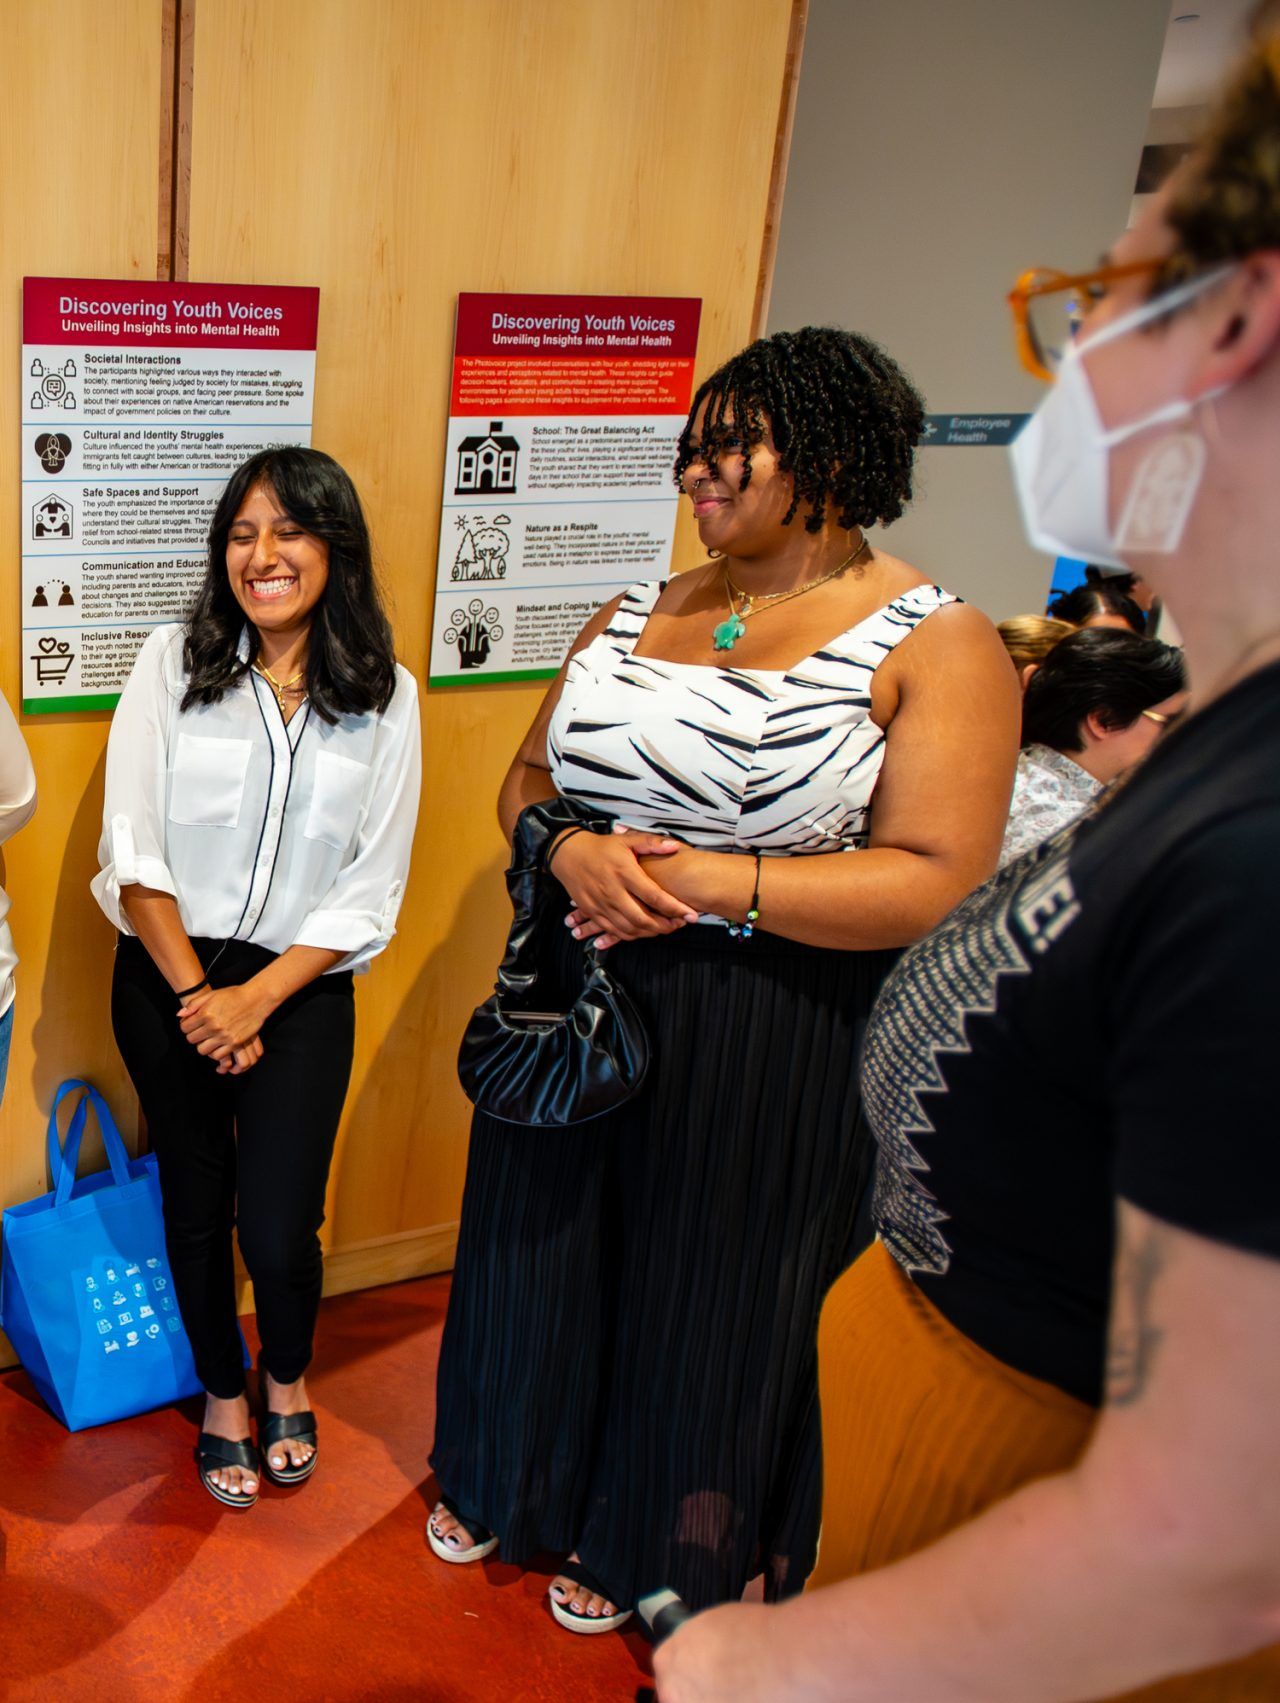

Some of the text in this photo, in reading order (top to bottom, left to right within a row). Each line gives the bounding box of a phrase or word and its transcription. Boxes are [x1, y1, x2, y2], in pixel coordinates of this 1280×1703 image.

[59, 296, 283, 321] Discovering Youth Voices
[62, 319, 280, 337] Unveiling Insights into Mental Health
[492, 313, 675, 334] Discovering Youth Voices
[492, 333, 672, 348] Unveiling Insights into Mental Health
[84, 353, 181, 365] Societal Interactions
[84, 366, 97, 374] The
[99, 367, 137, 376] participants
[139, 367, 175, 377] highlighted
[220, 369, 234, 377] they
[236, 369, 267, 377] interacted
[156, 389, 180, 397] groups,
[197, 388, 216, 397] facing
[234, 390, 264, 398] pressure.
[265, 389, 284, 397] Some
[285, 390, 304, 398] spoke
[950, 417, 1010, 430] Employee
[83, 430, 224, 442] Cultural and Identity Struggles
[532, 426, 655, 436] School: The Great Balancing Act
[947, 432, 987, 442] Health
[83, 487, 199, 499] Safe Spaces and Support
[97, 500, 115, 509] youth
[117, 499, 156, 508] emphasized
[170, 499, 205, 507] importance
[525, 524, 551, 532] Nature
[570, 522, 598, 532] Respite
[82, 560, 154, 571] Communication
[156, 560, 174, 569] and
[516, 604, 546, 613] Mindset
[547, 603, 562, 611] and
[563, 601, 590, 612] Coping
[81, 631, 122, 641] Inclusive
